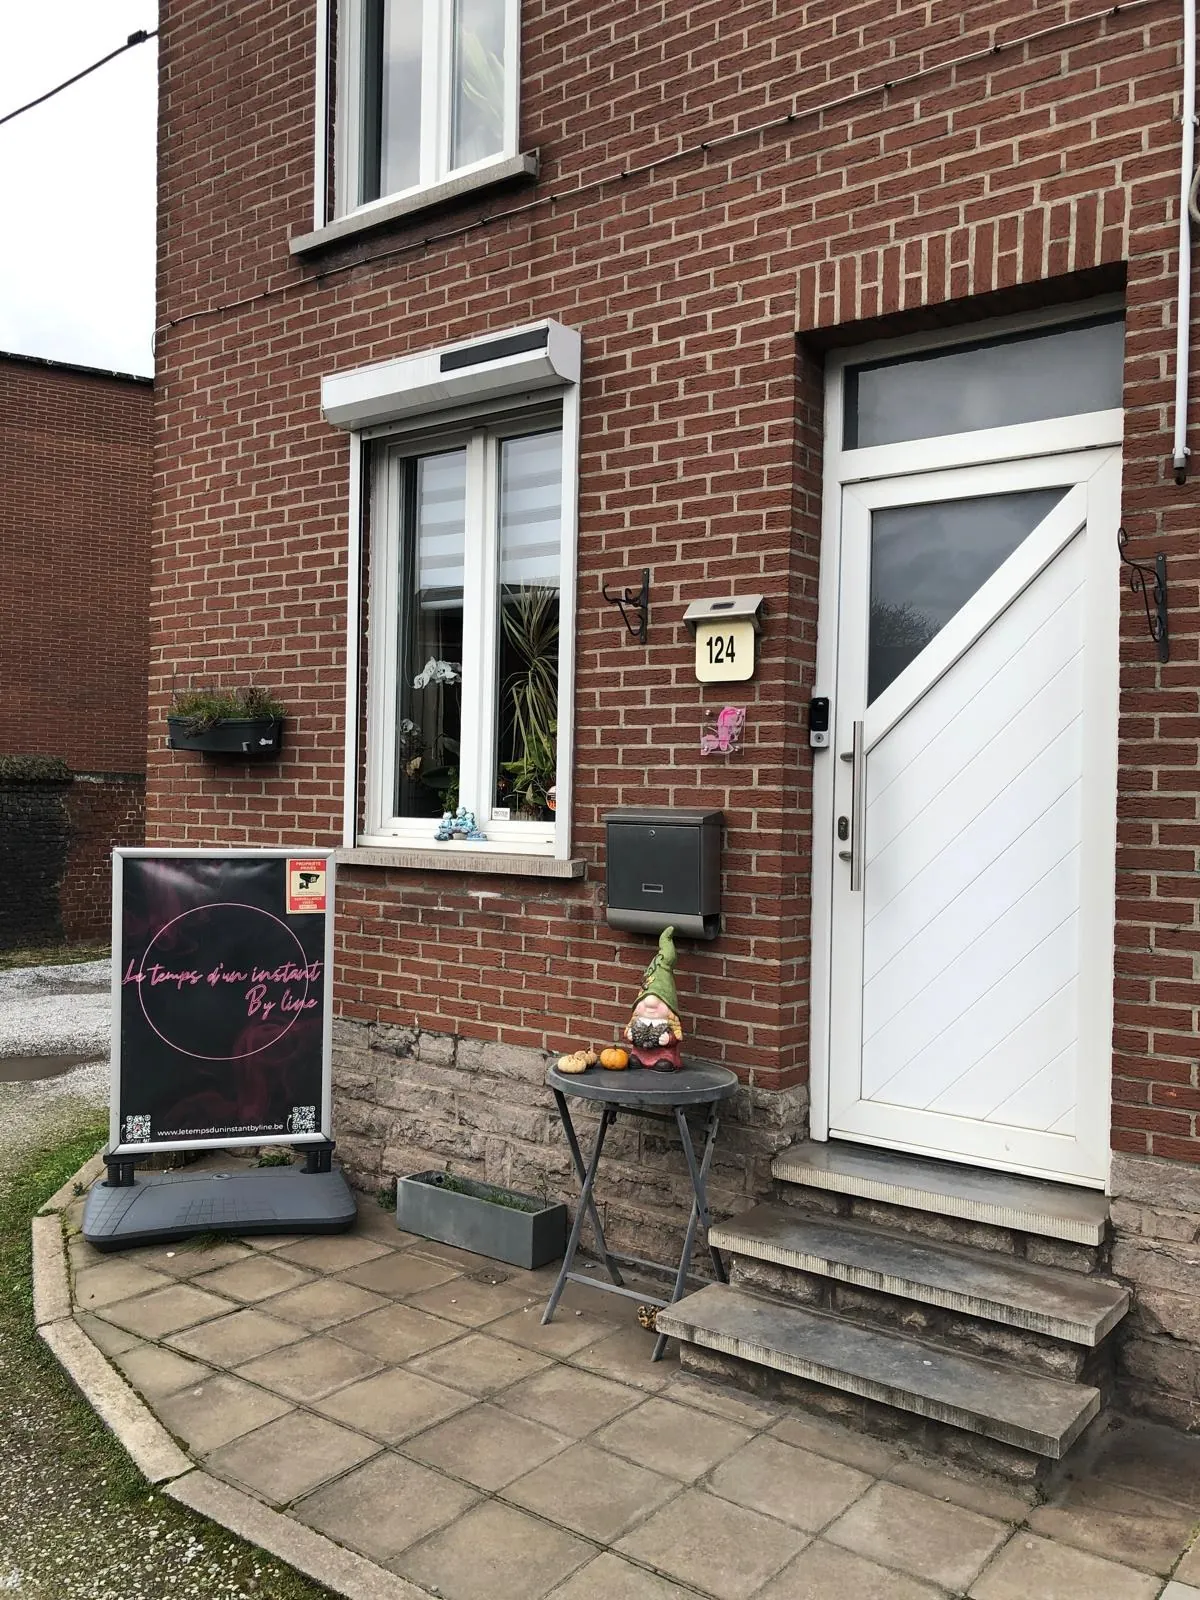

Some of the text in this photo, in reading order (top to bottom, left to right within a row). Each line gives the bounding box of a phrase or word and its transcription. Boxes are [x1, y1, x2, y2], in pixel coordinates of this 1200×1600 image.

[706, 635, 736, 664] 124
[121, 958, 325, 991] Le temps d'un instant
[245, 983, 318, 1020] By line
[157, 1124, 284, 1137] www.letempsduninstantbyline.be
